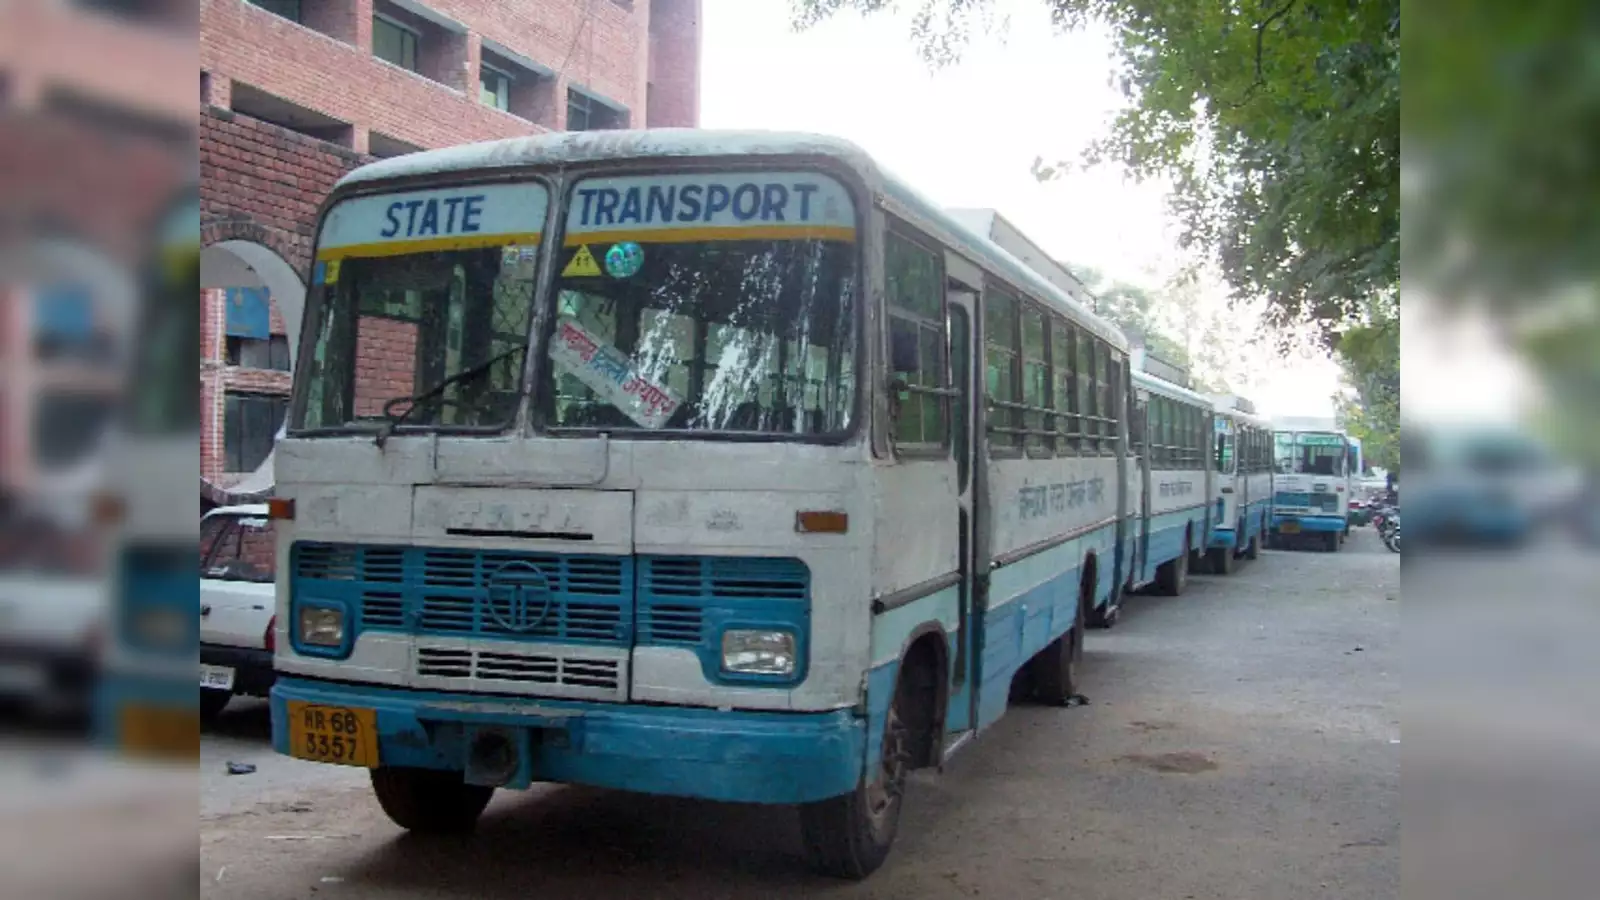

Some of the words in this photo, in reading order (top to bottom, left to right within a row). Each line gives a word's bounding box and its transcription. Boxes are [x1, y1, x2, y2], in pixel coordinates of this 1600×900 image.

[381, 195, 485, 237] STATE
[577, 183, 819, 225] TRANSPORT
[304, 731, 357, 761] 3357
